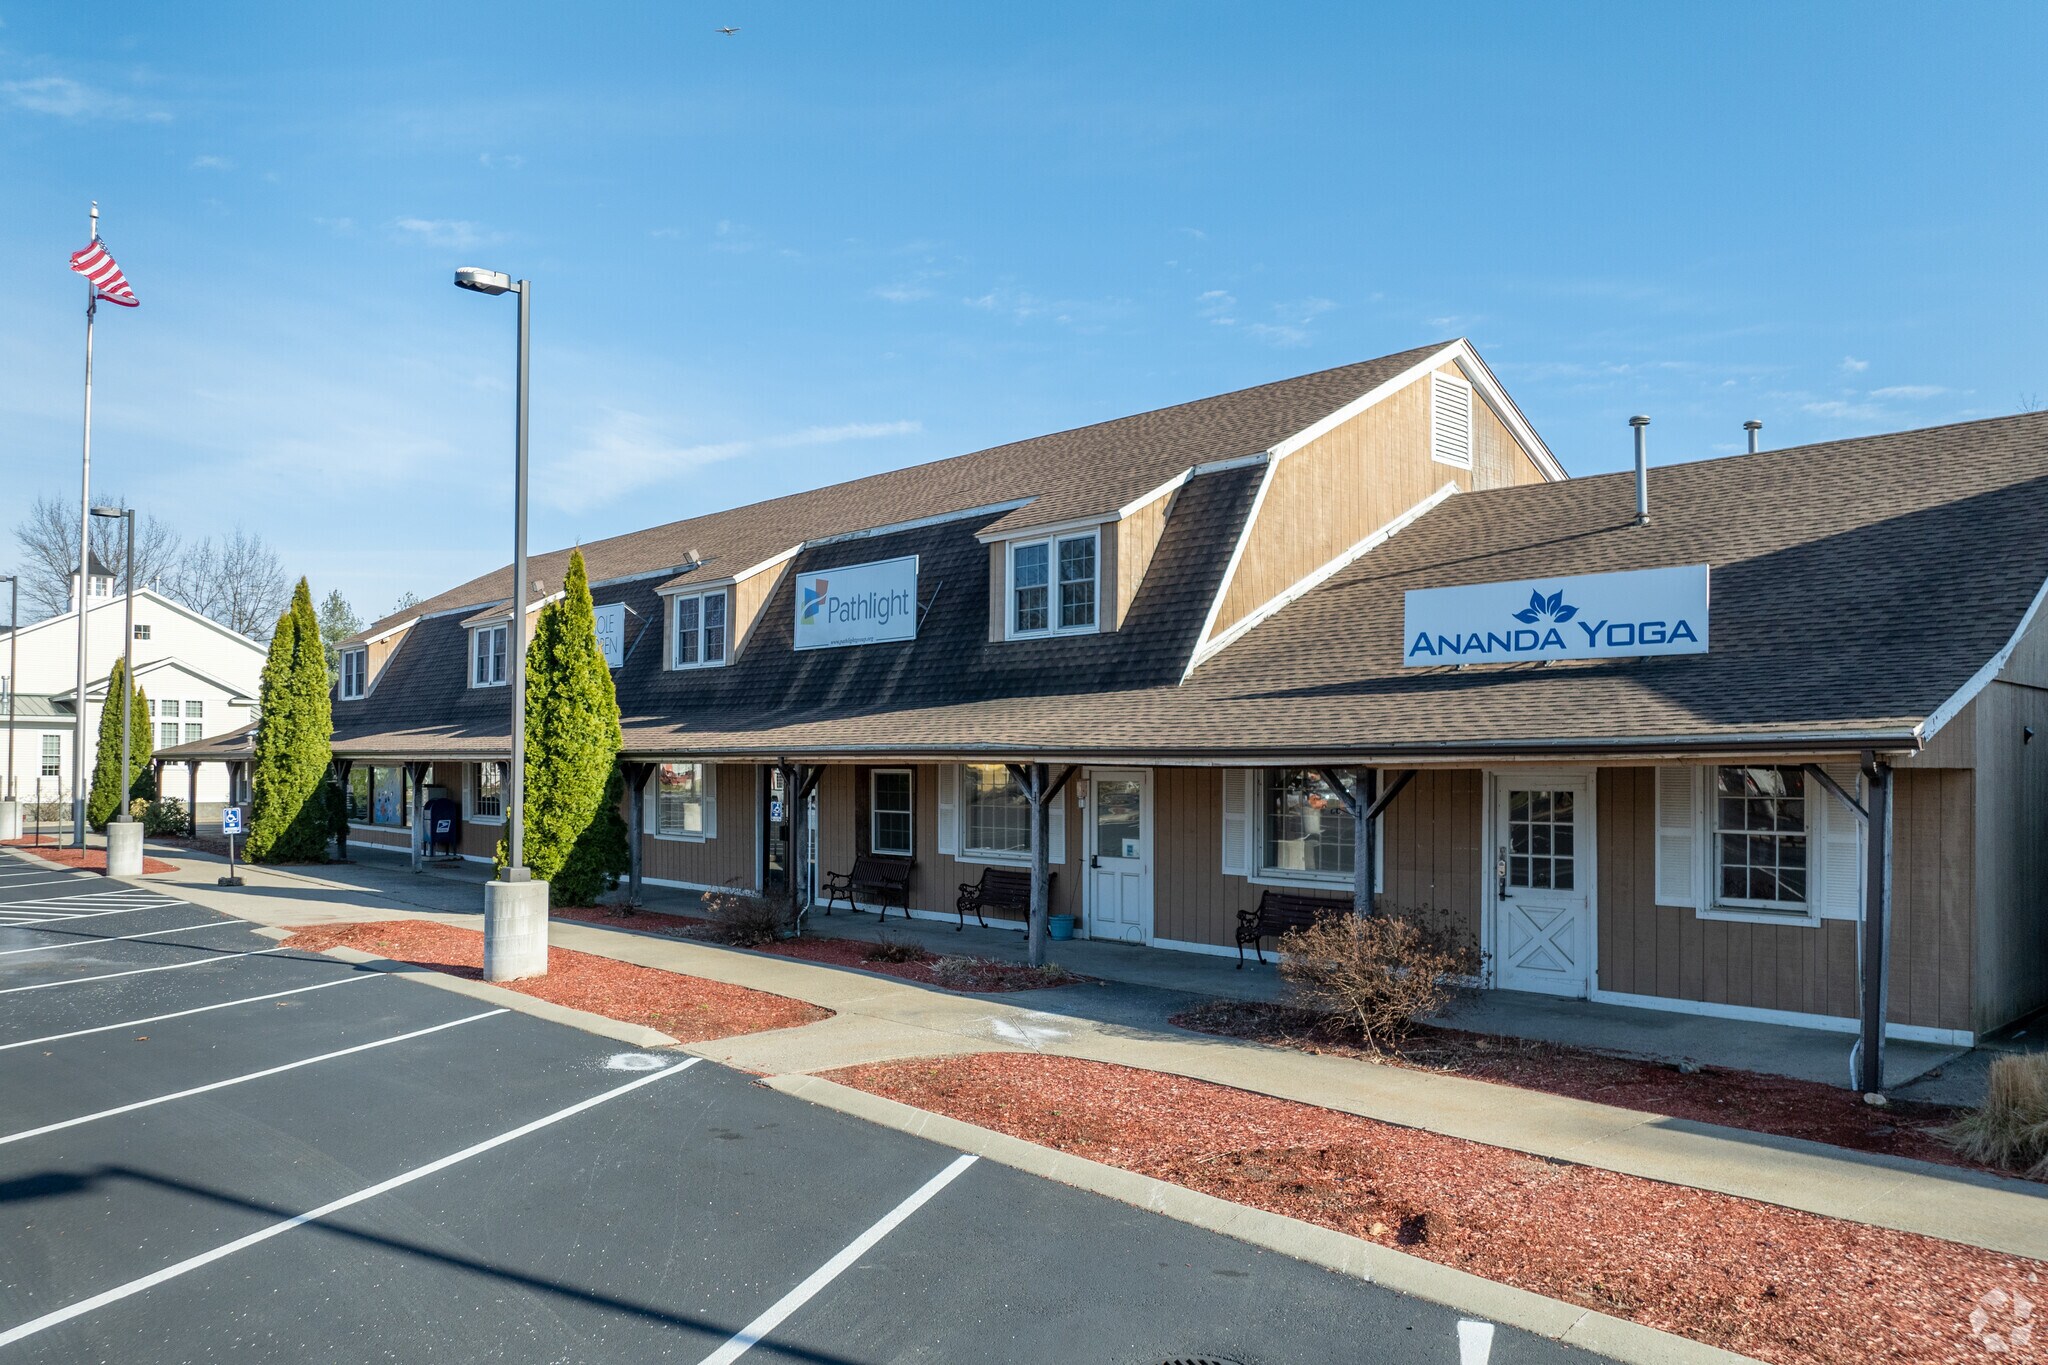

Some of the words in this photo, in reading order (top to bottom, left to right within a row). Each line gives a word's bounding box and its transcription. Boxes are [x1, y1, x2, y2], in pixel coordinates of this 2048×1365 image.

[828, 589, 909, 625] Pathlight
[595, 614, 614, 634] OLE
[1409, 627, 1567, 657] ANANDA
[1577, 619, 1699, 648] YOGA
[596, 636, 618, 655] PEN
